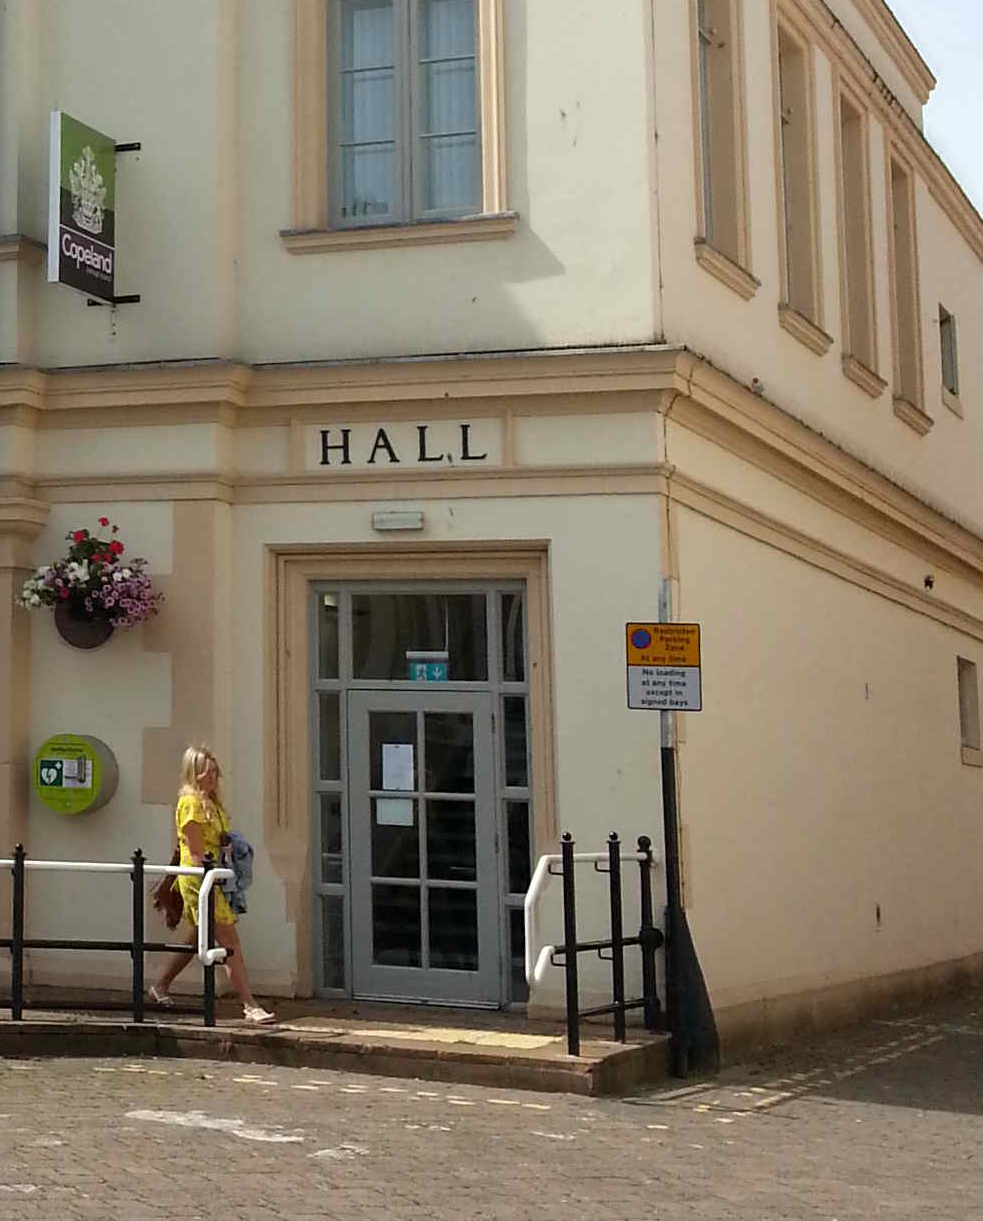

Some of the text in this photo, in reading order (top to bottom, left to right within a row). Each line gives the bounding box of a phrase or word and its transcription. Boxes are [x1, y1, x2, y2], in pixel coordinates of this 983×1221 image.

[62, 233, 112, 274] Copeland
[319, 424, 488, 465] HALL
[642, 668, 686, 678] No loading
[668, 679, 686, 687] time
[646, 689, 673, 697] except
[641, 698, 688, 707] signed bays
